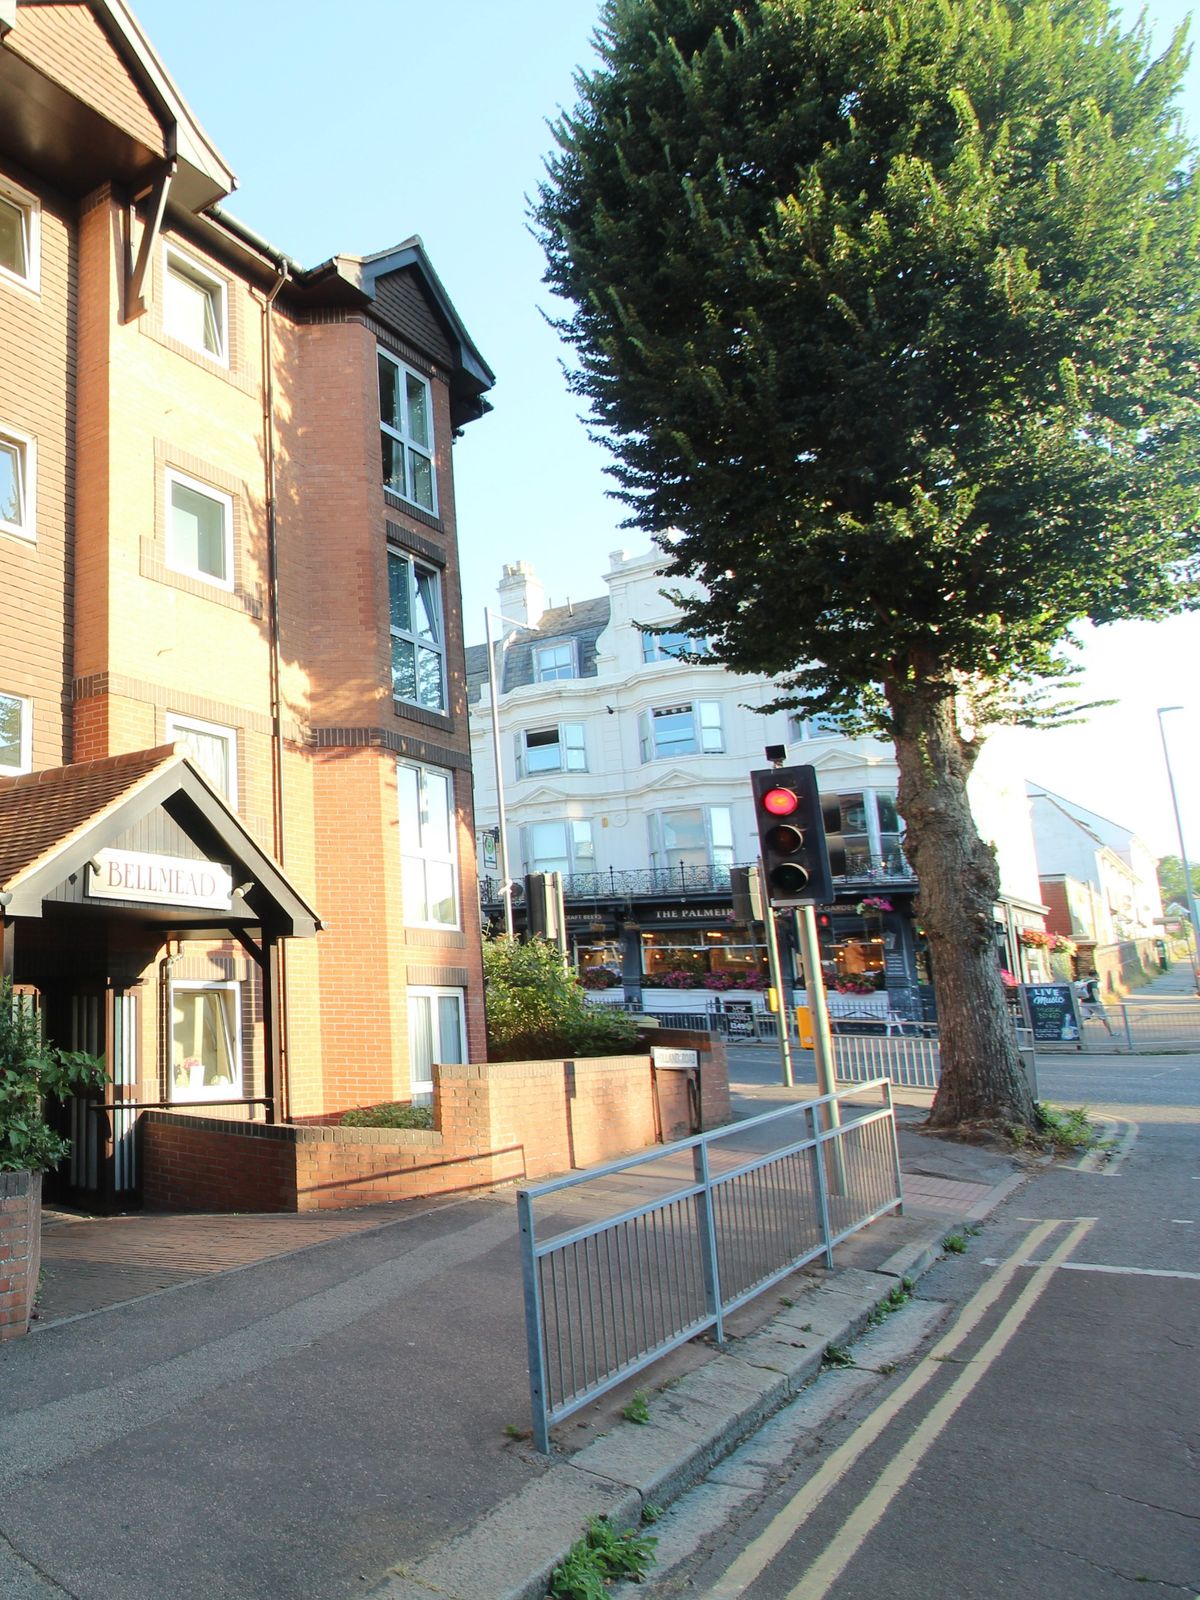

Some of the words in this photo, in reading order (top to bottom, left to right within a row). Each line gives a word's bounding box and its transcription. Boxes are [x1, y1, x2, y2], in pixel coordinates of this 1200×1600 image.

[107, 861, 216, 897] BELLMEAD
[656, 910, 678, 919] THE
[681, 908, 735, 918] PALMEIR
[1034, 988, 1060, 996] LIVE
